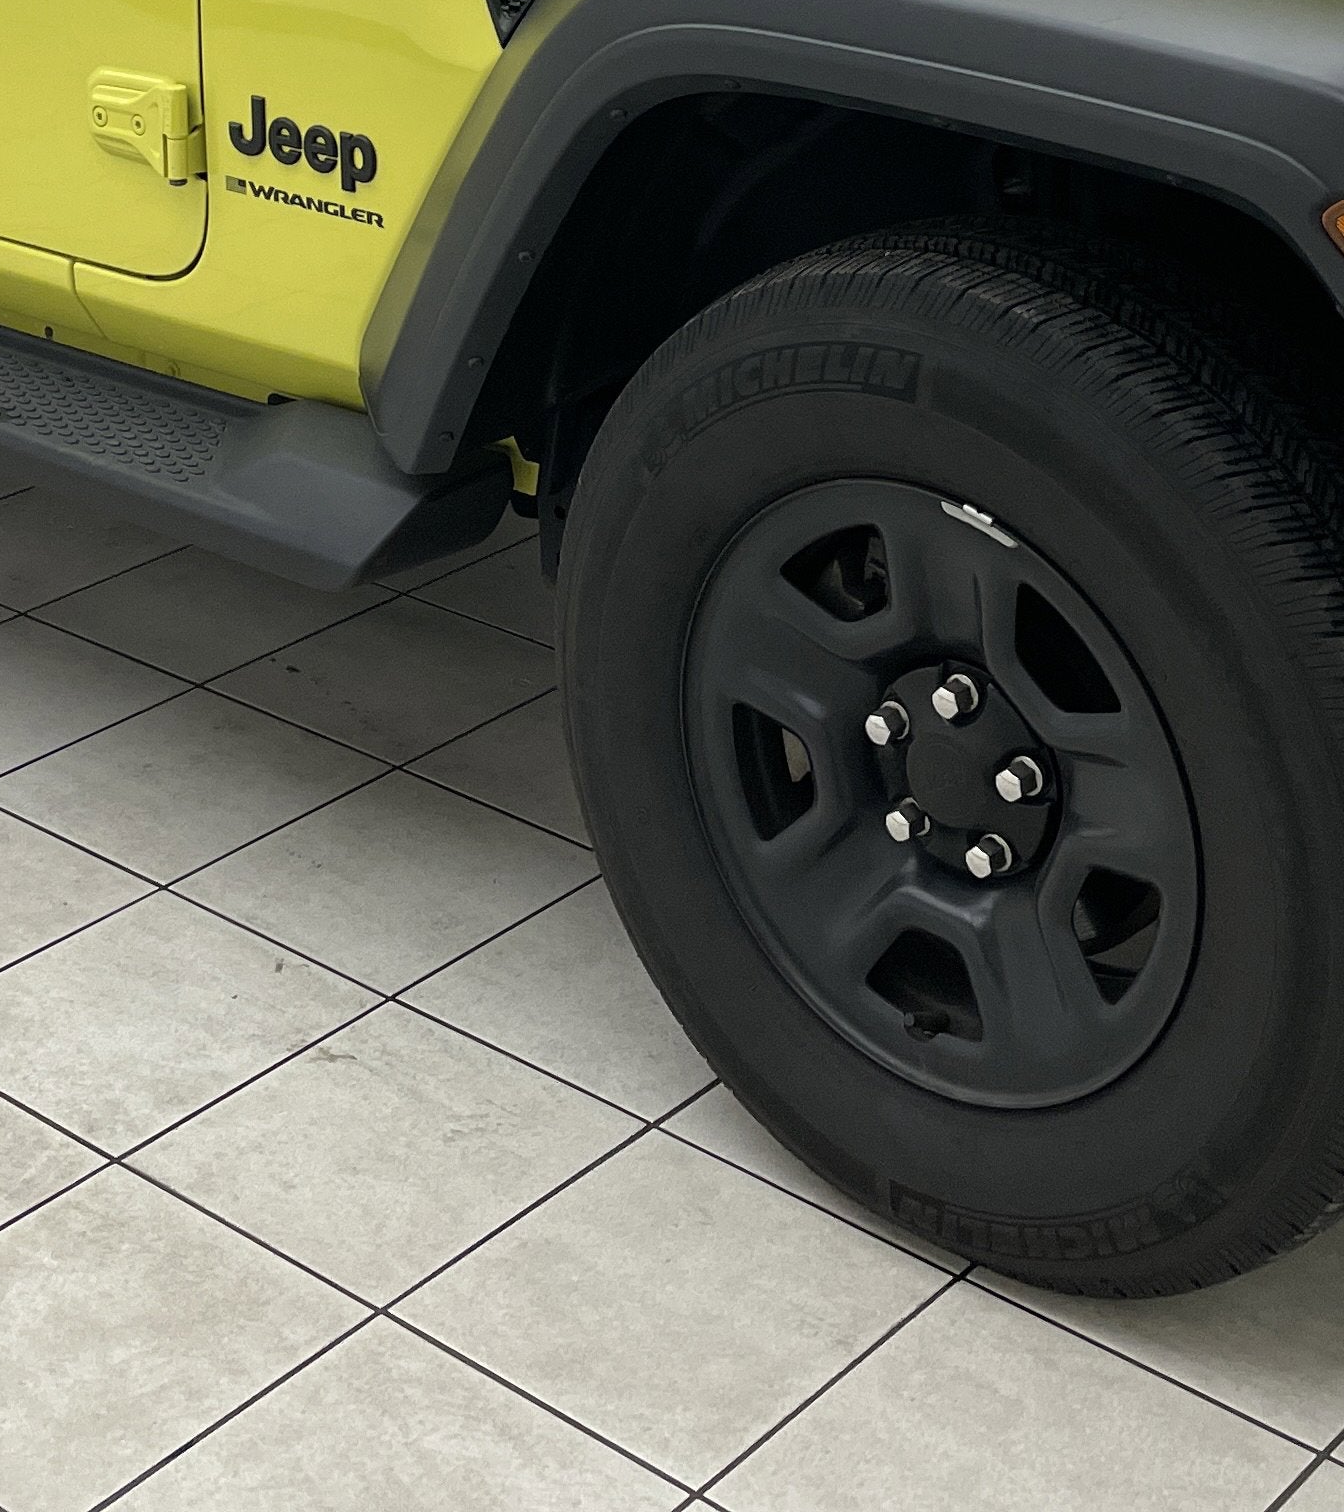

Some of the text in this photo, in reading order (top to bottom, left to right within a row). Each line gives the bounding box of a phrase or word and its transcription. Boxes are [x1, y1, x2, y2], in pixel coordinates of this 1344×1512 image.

[228, 94, 378, 193] Jeep
[248, 180, 385, 229] WRANGLER
[680, 343, 916, 430] MICHELIN
